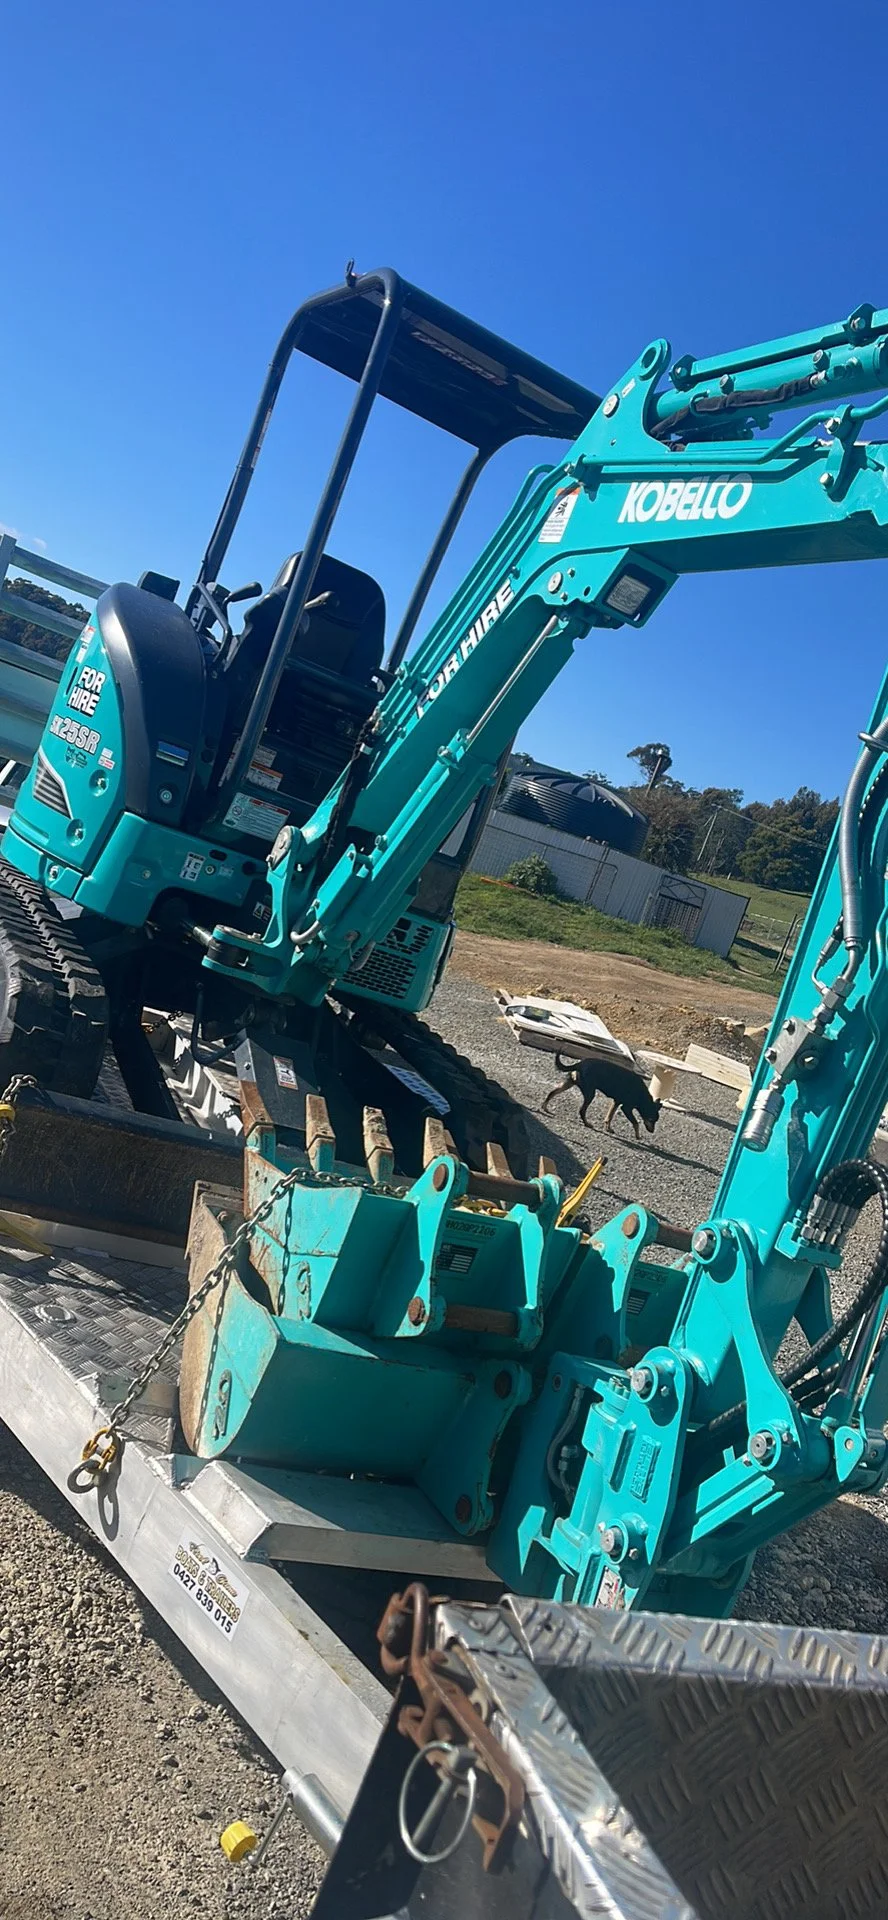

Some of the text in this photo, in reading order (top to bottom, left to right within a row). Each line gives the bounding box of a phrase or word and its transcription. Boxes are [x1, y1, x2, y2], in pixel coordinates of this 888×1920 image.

[617, 473, 753, 523] KOBELCO
[459, 578, 515, 662] HIRE
[67, 686, 101, 717] HIRE
[78, 665, 106, 695] FOR
[50, 714, 101, 755] SK25SR
[173, 1563, 233, 1634] 0427 839 015
[175, 1545, 200, 1578] BOATS
[204, 1575, 241, 1624] TRAILERS
